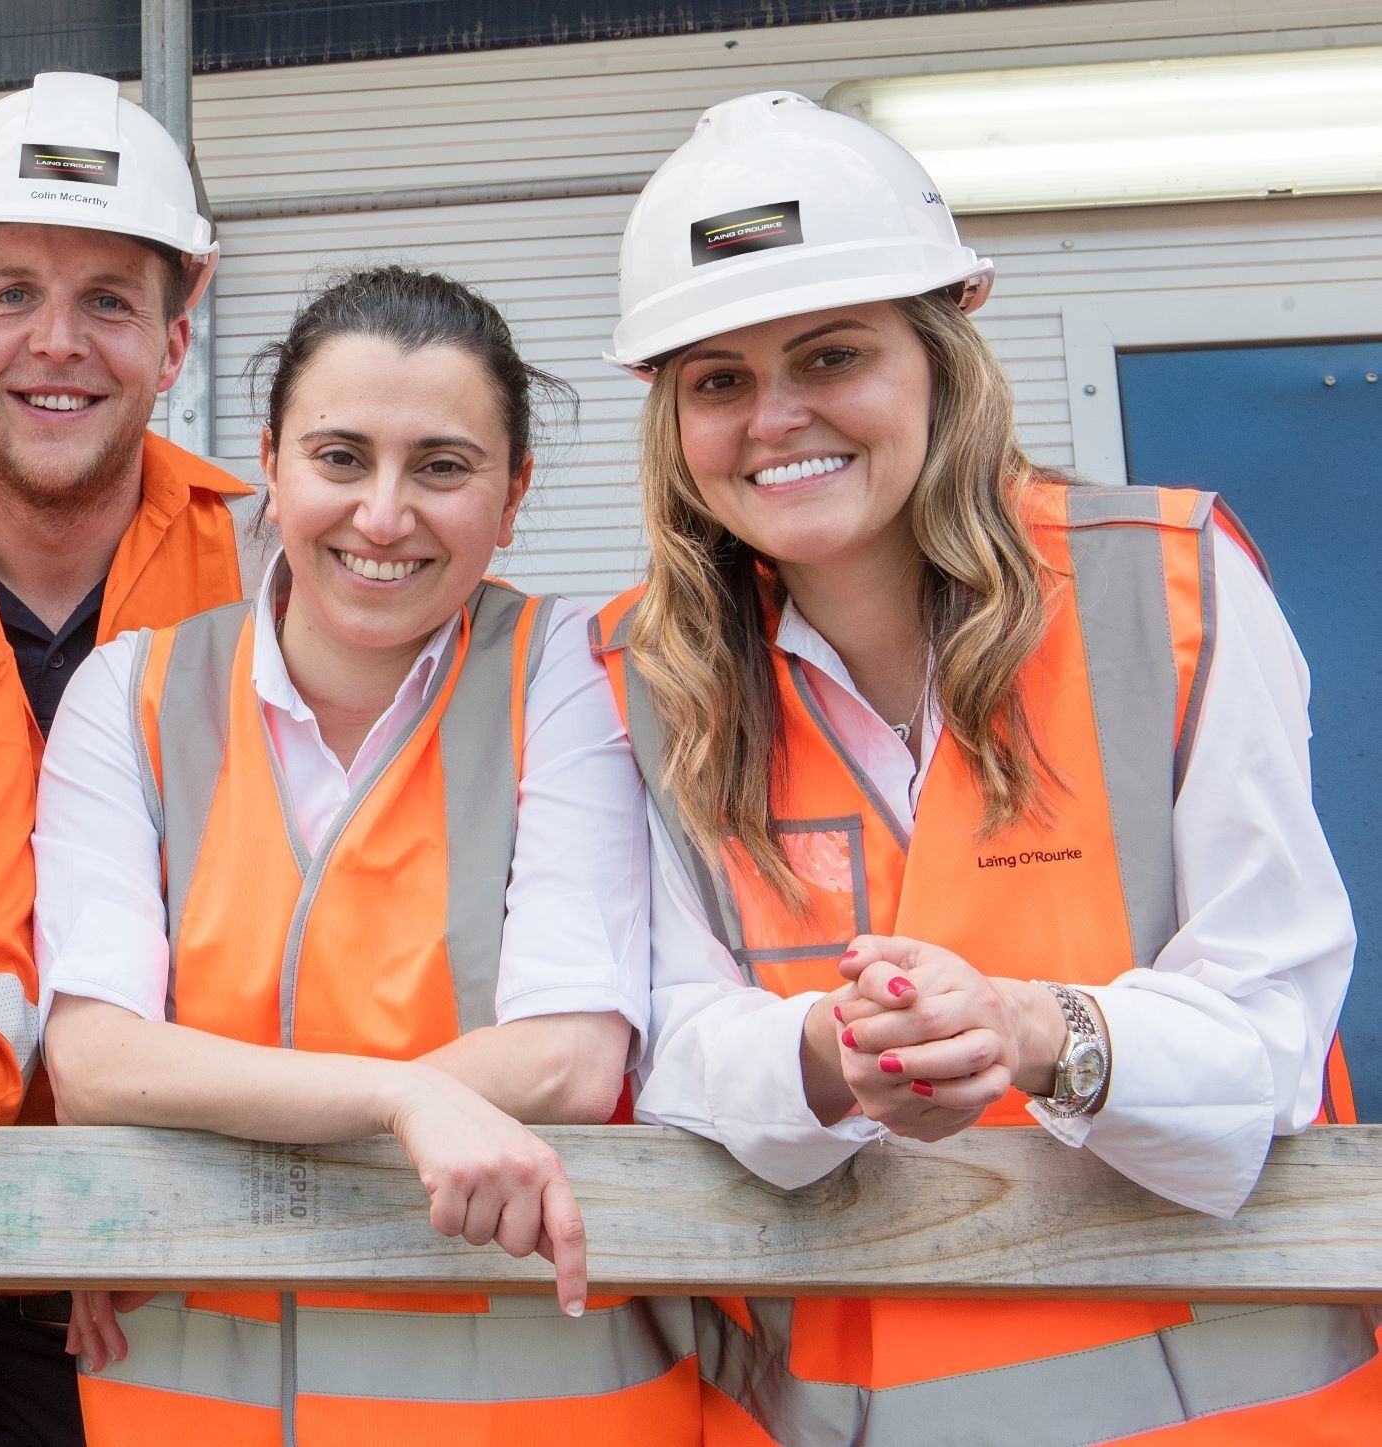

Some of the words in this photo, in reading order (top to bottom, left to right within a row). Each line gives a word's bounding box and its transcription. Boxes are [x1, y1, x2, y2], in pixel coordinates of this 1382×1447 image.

[62, 161, 104, 171] O'ROURKE
[30, 190, 57, 200] Colin
[59, 192, 108, 208] McCarthy
[708, 231, 736, 243] LAING
[737, 221, 783, 236] O'ROURKE
[977, 855, 1017, 868] Laing
[1019, 848, 1083, 864] O'Rourke
[289, 1143, 308, 1218] MGP10
